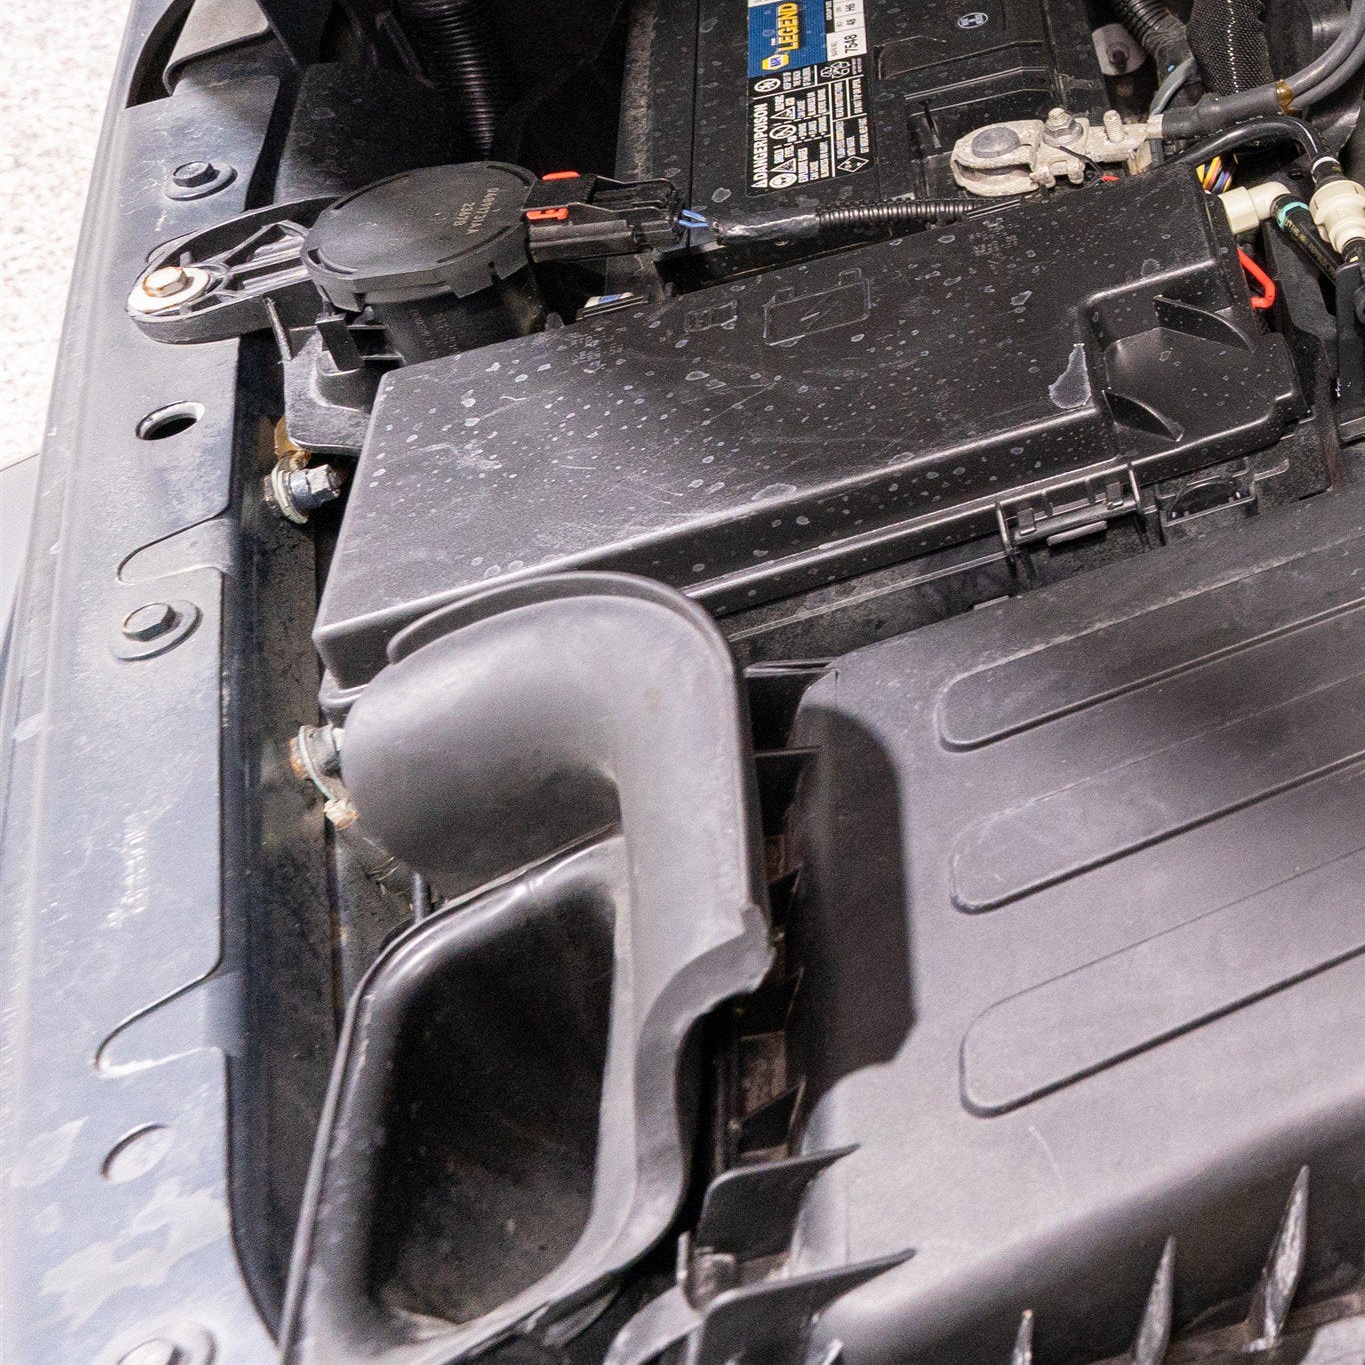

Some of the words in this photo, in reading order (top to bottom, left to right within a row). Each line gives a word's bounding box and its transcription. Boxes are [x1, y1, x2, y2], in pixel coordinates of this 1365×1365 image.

[777, 2, 799, 51] LEGEND
[844, 34, 858, 54] 7548
[753, 102, 768, 181] DANGER/POISON
